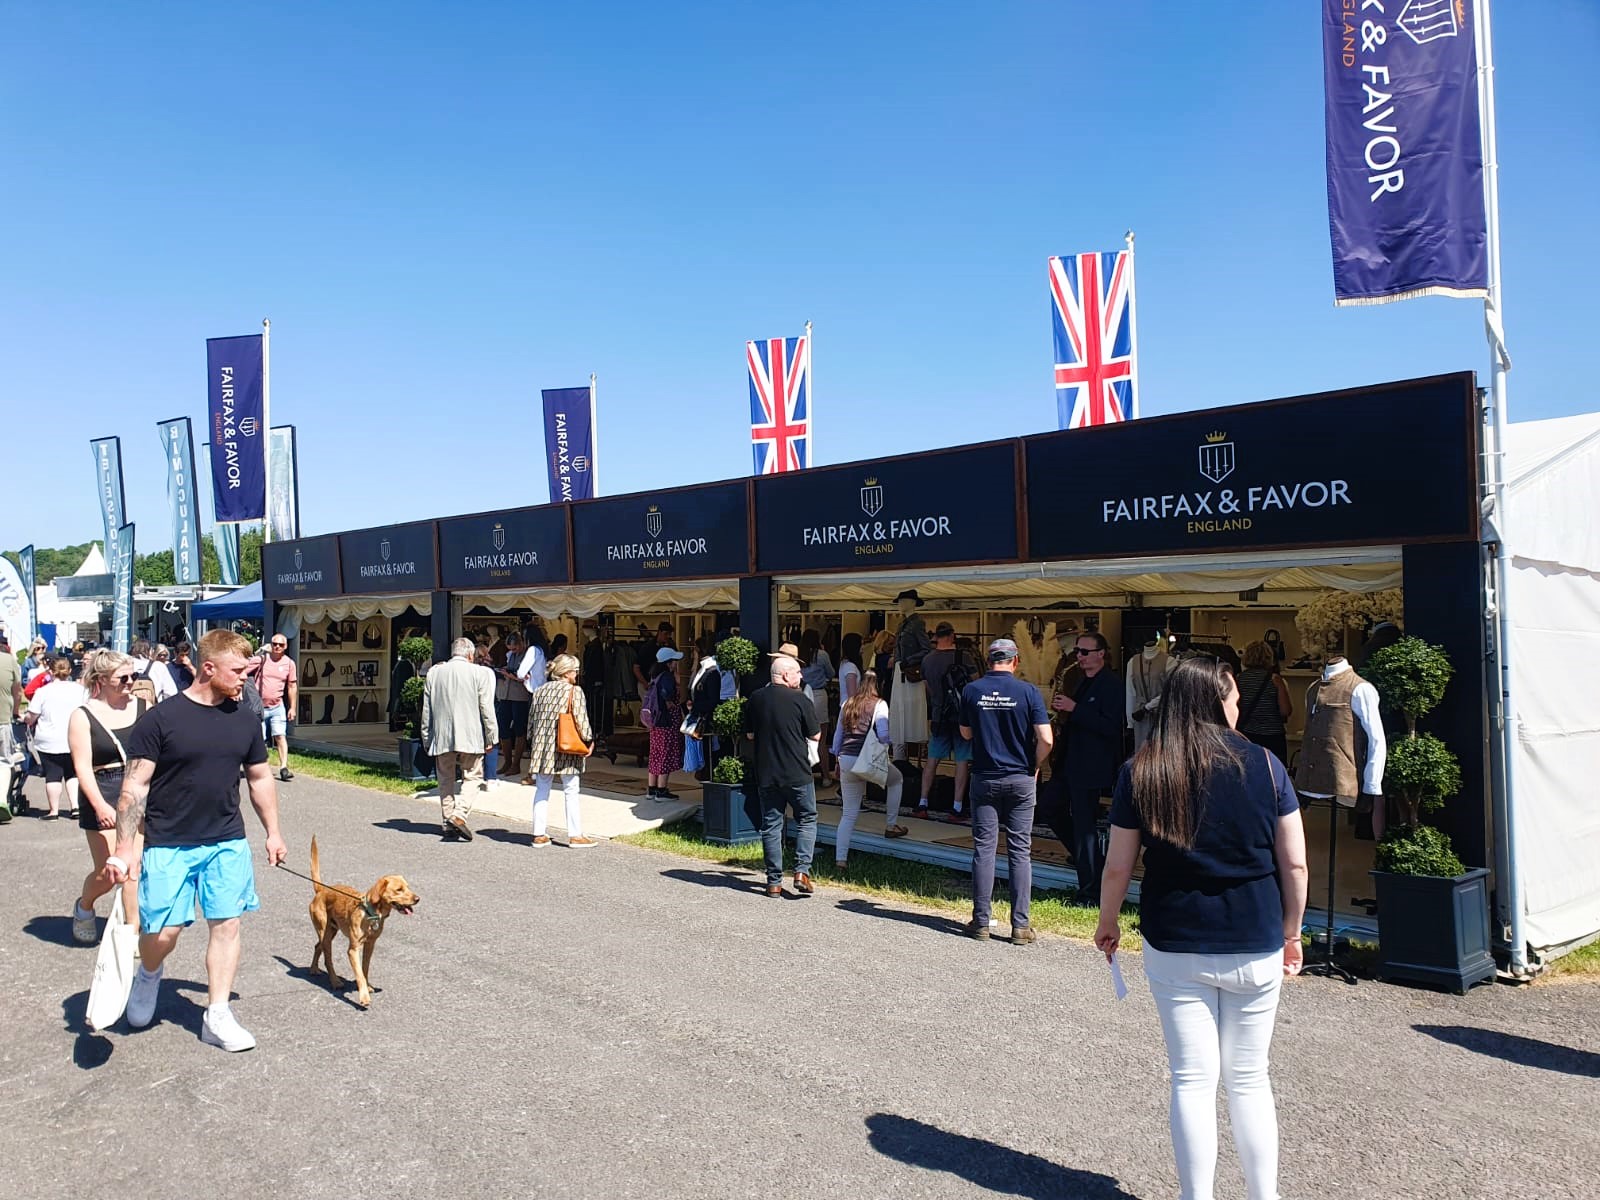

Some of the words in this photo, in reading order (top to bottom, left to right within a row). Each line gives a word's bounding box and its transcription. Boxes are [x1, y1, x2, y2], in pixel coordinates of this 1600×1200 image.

[1342, 0, 1356, 68] GLAND
[1361, 19, 1387, 53] &
[1361, 65, 1405, 203] FAVOR
[221, 366, 235, 426] FAIRFAX
[215, 412, 223, 445] ENGLAND
[223, 428, 236, 439] &
[555, 413, 569, 463] FAIRFAX
[225, 442, 241, 489] FAVOR
[560, 465, 570, 474] &
[561, 476, 573, 502] FAV
[1103, 491, 1213, 523] FAIRFAX
[1218, 489, 1240, 514] &
[1248, 479, 1352, 512] FAVOR
[803, 522, 871, 546] FAIRFAX
[873, 521, 887, 541] &
[890, 516, 952, 539] FAVOR
[1187, 517, 1252, 533] ENGLAND
[464, 553, 499, 569] FAIRFAX
[499, 553, 507, 567] &
[508, 551, 538, 567] FAVOR
[607, 542, 654, 561] FAIRFAX
[655, 541, 665, 557] &
[667, 538, 707, 555] FAVOR
[855, 543, 894, 555] ENGLAND
[277, 572, 299, 585] FAIRFAX
[304, 570, 322, 583] FAVOR
[360, 564, 386, 577] FAIRFAX
[393, 561, 416, 575] FAVOR
[643, 560, 670, 569] ENGLAND
